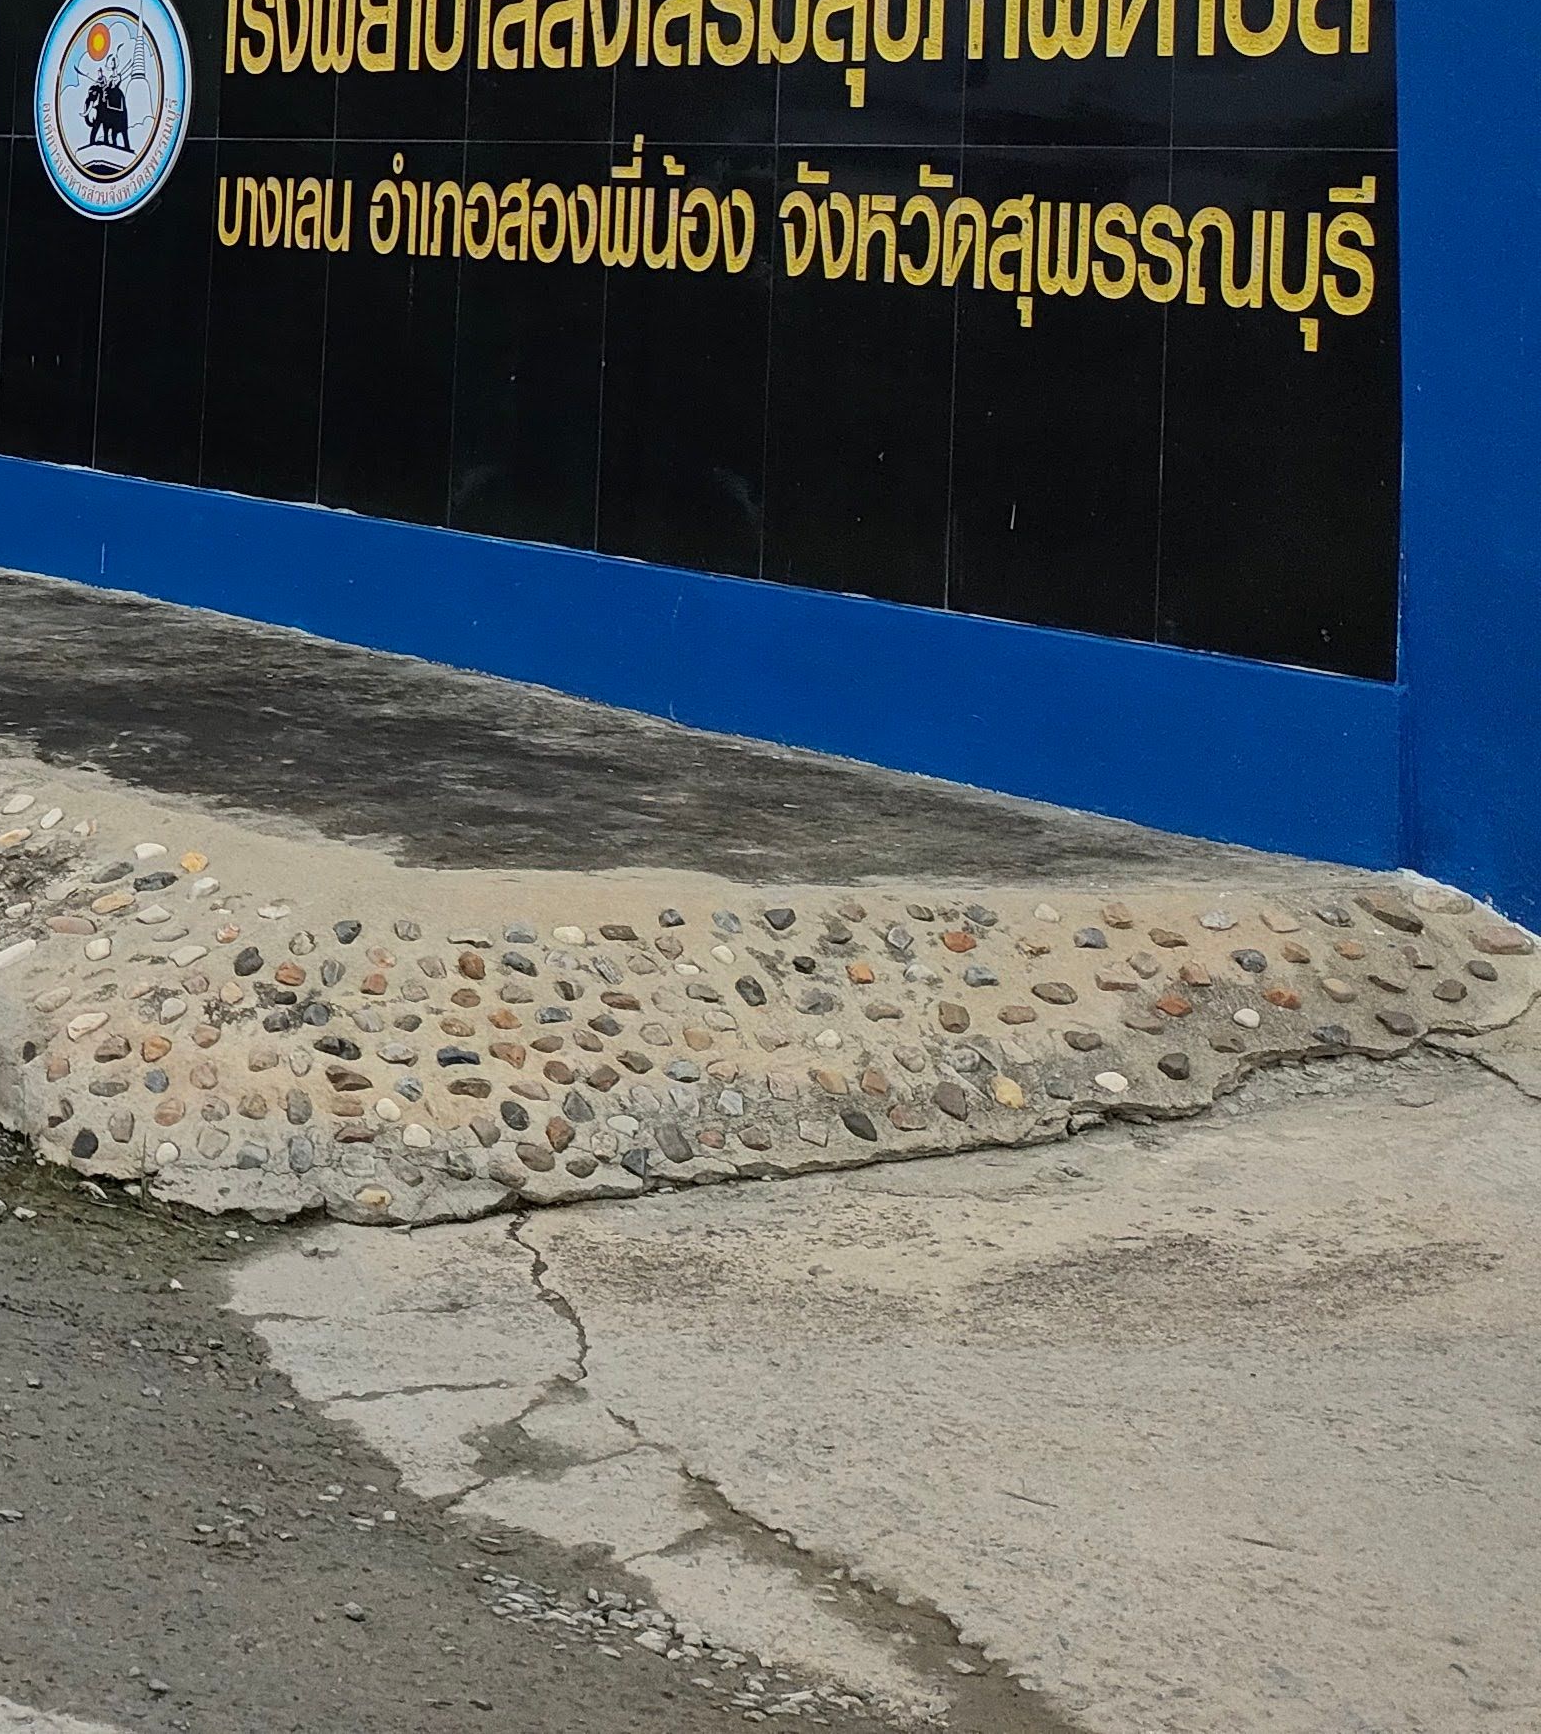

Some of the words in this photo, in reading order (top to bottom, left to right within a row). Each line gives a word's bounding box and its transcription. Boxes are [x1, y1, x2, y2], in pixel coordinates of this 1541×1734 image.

[217, 176, 351, 252] บางเลน
[370, 134, 755, 273] อำเภอสองพี่น้อง
[779, 161, 1376, 352] จังหวัดสุพรรณบุรี
